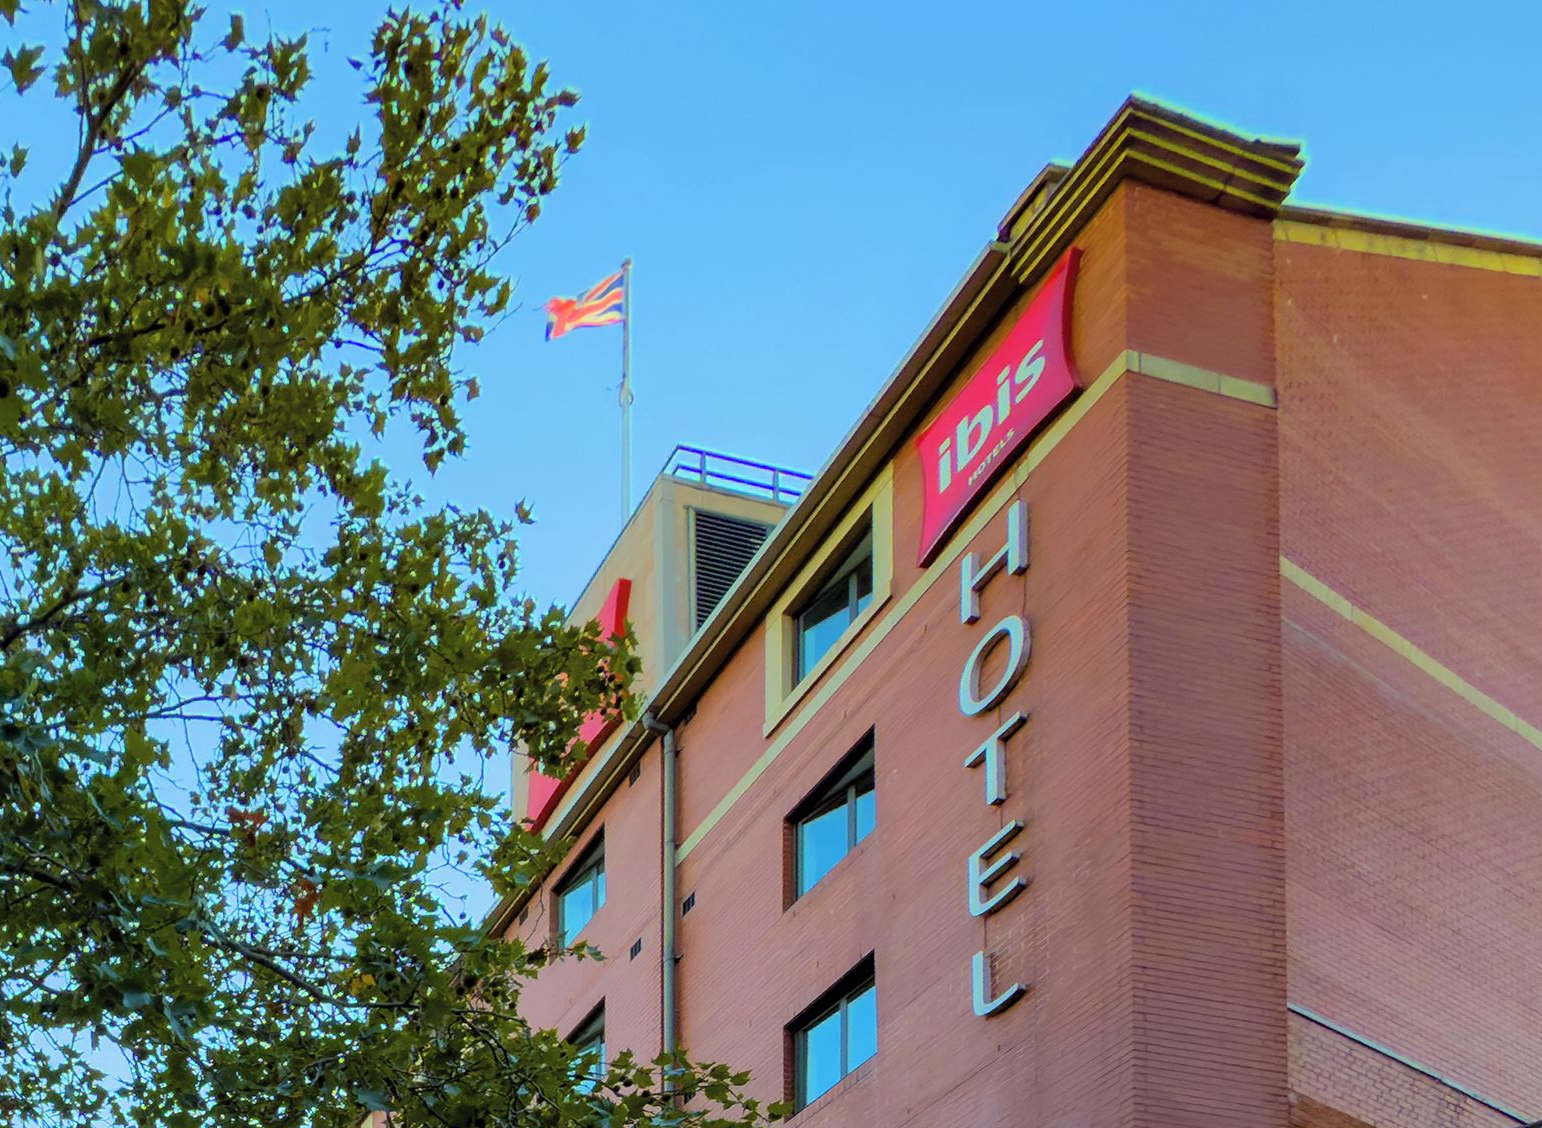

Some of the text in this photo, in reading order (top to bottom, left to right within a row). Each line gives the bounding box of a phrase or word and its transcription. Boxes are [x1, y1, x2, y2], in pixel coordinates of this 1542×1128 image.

[937, 338, 1048, 494] ibis
[968, 428, 1016, 486] HOTELS
[958, 499, 1032, 1019] HOTEL
